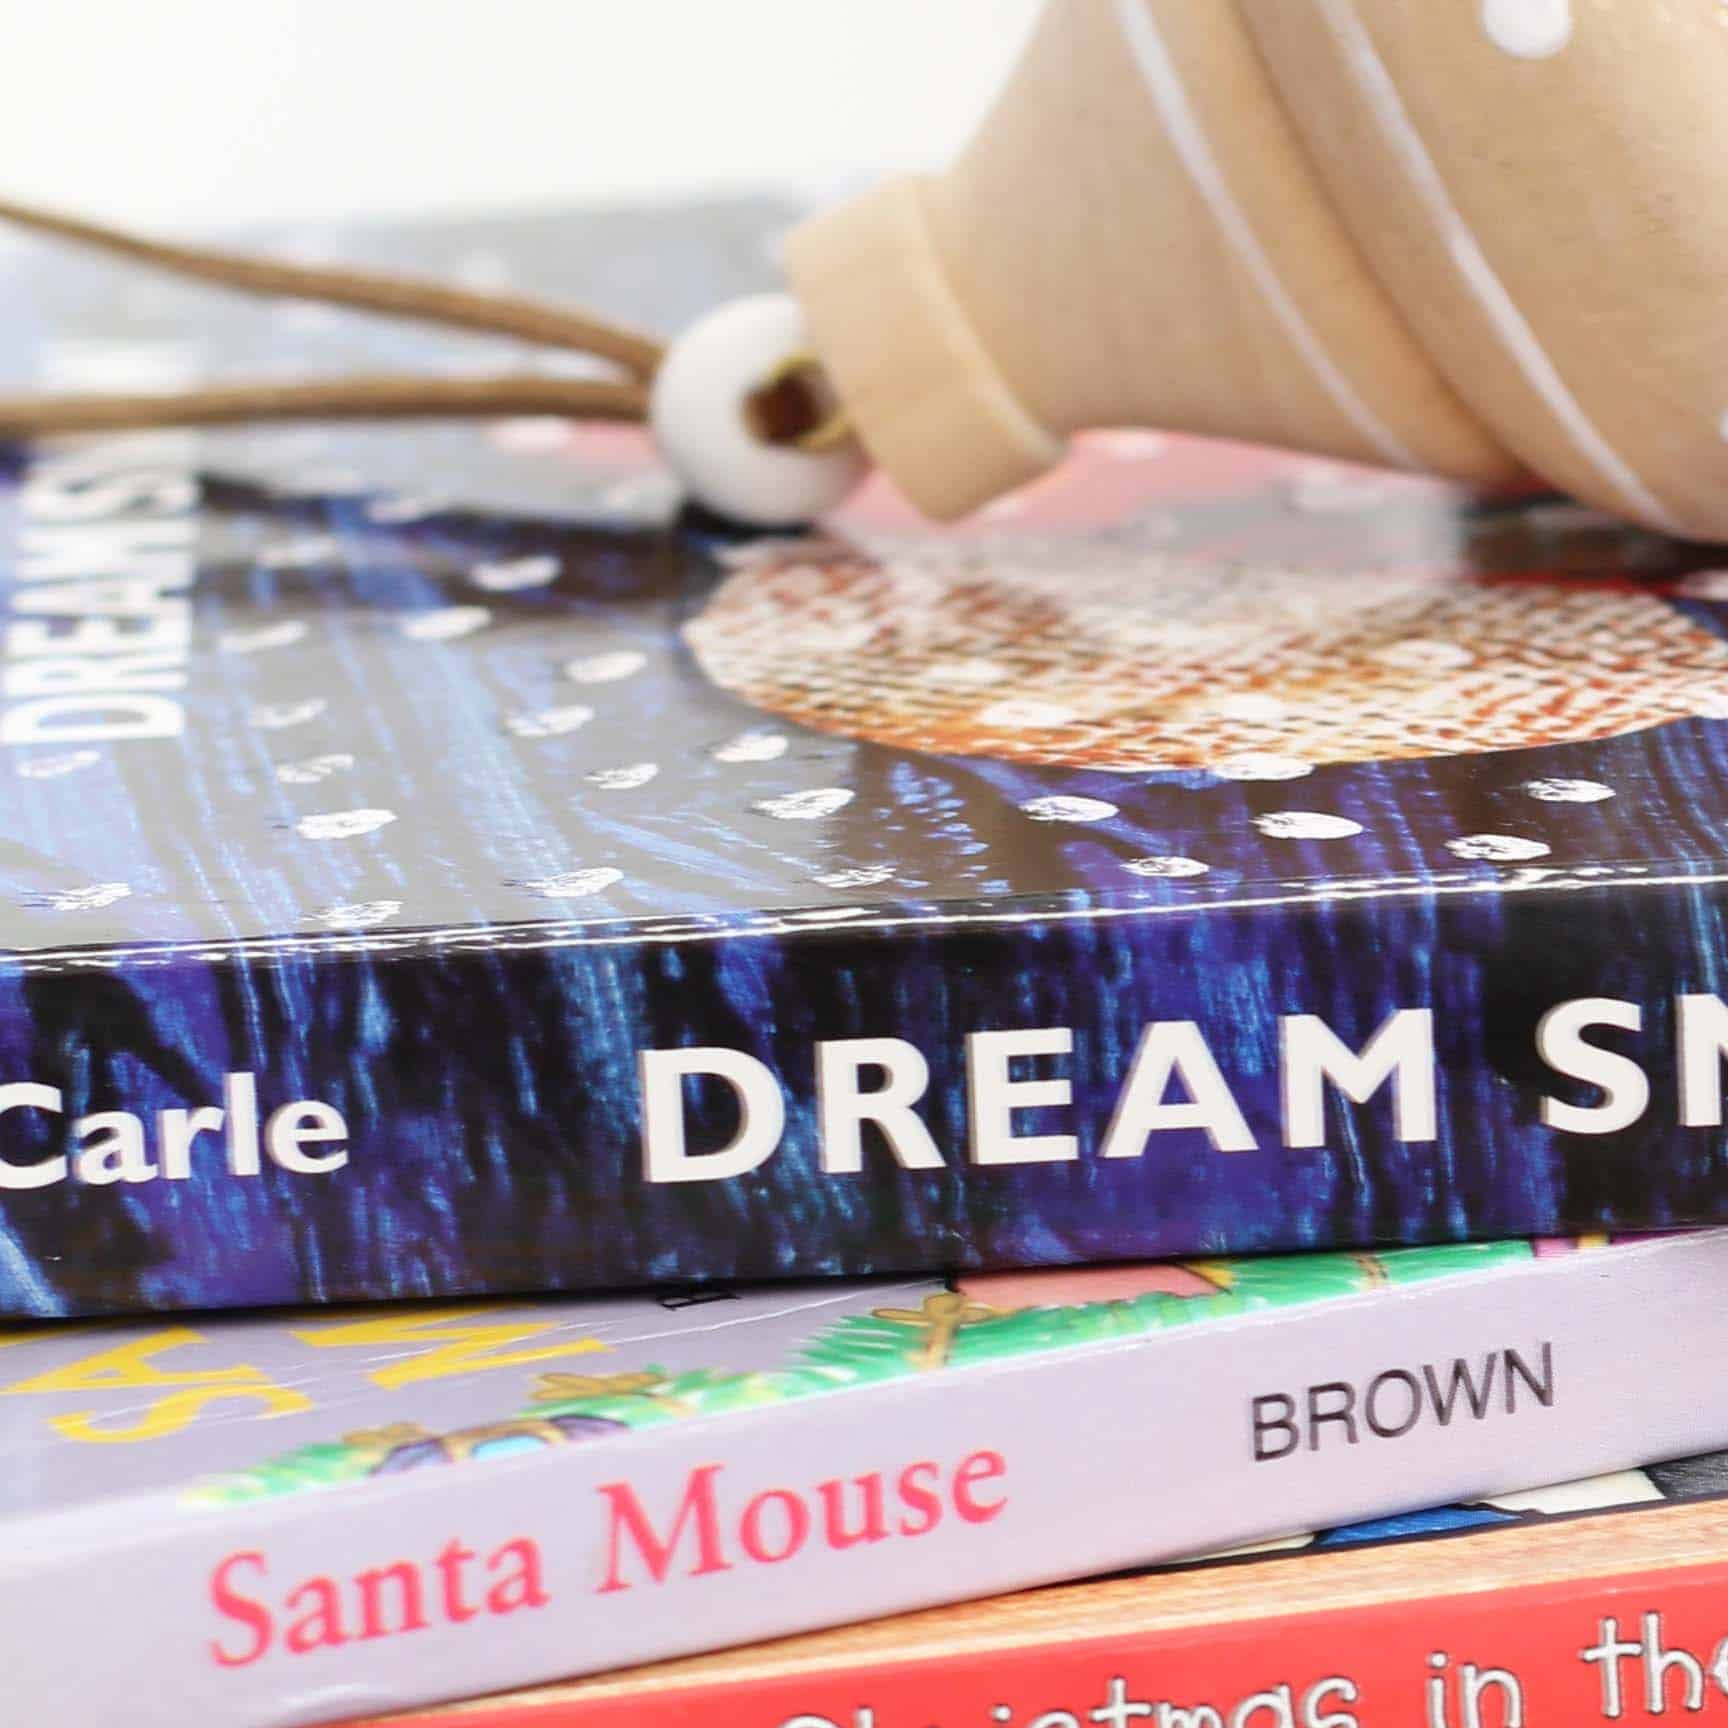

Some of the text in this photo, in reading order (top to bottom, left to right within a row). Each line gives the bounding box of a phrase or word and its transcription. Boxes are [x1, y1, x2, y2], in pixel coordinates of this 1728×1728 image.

[0, 1072, 350, 1189] Carle
[639, 1007, 1436, 1184] DREAM
[1250, 1341, 1556, 1462] BROWN
[208, 1447, 1010, 1671] Santa Mouse
